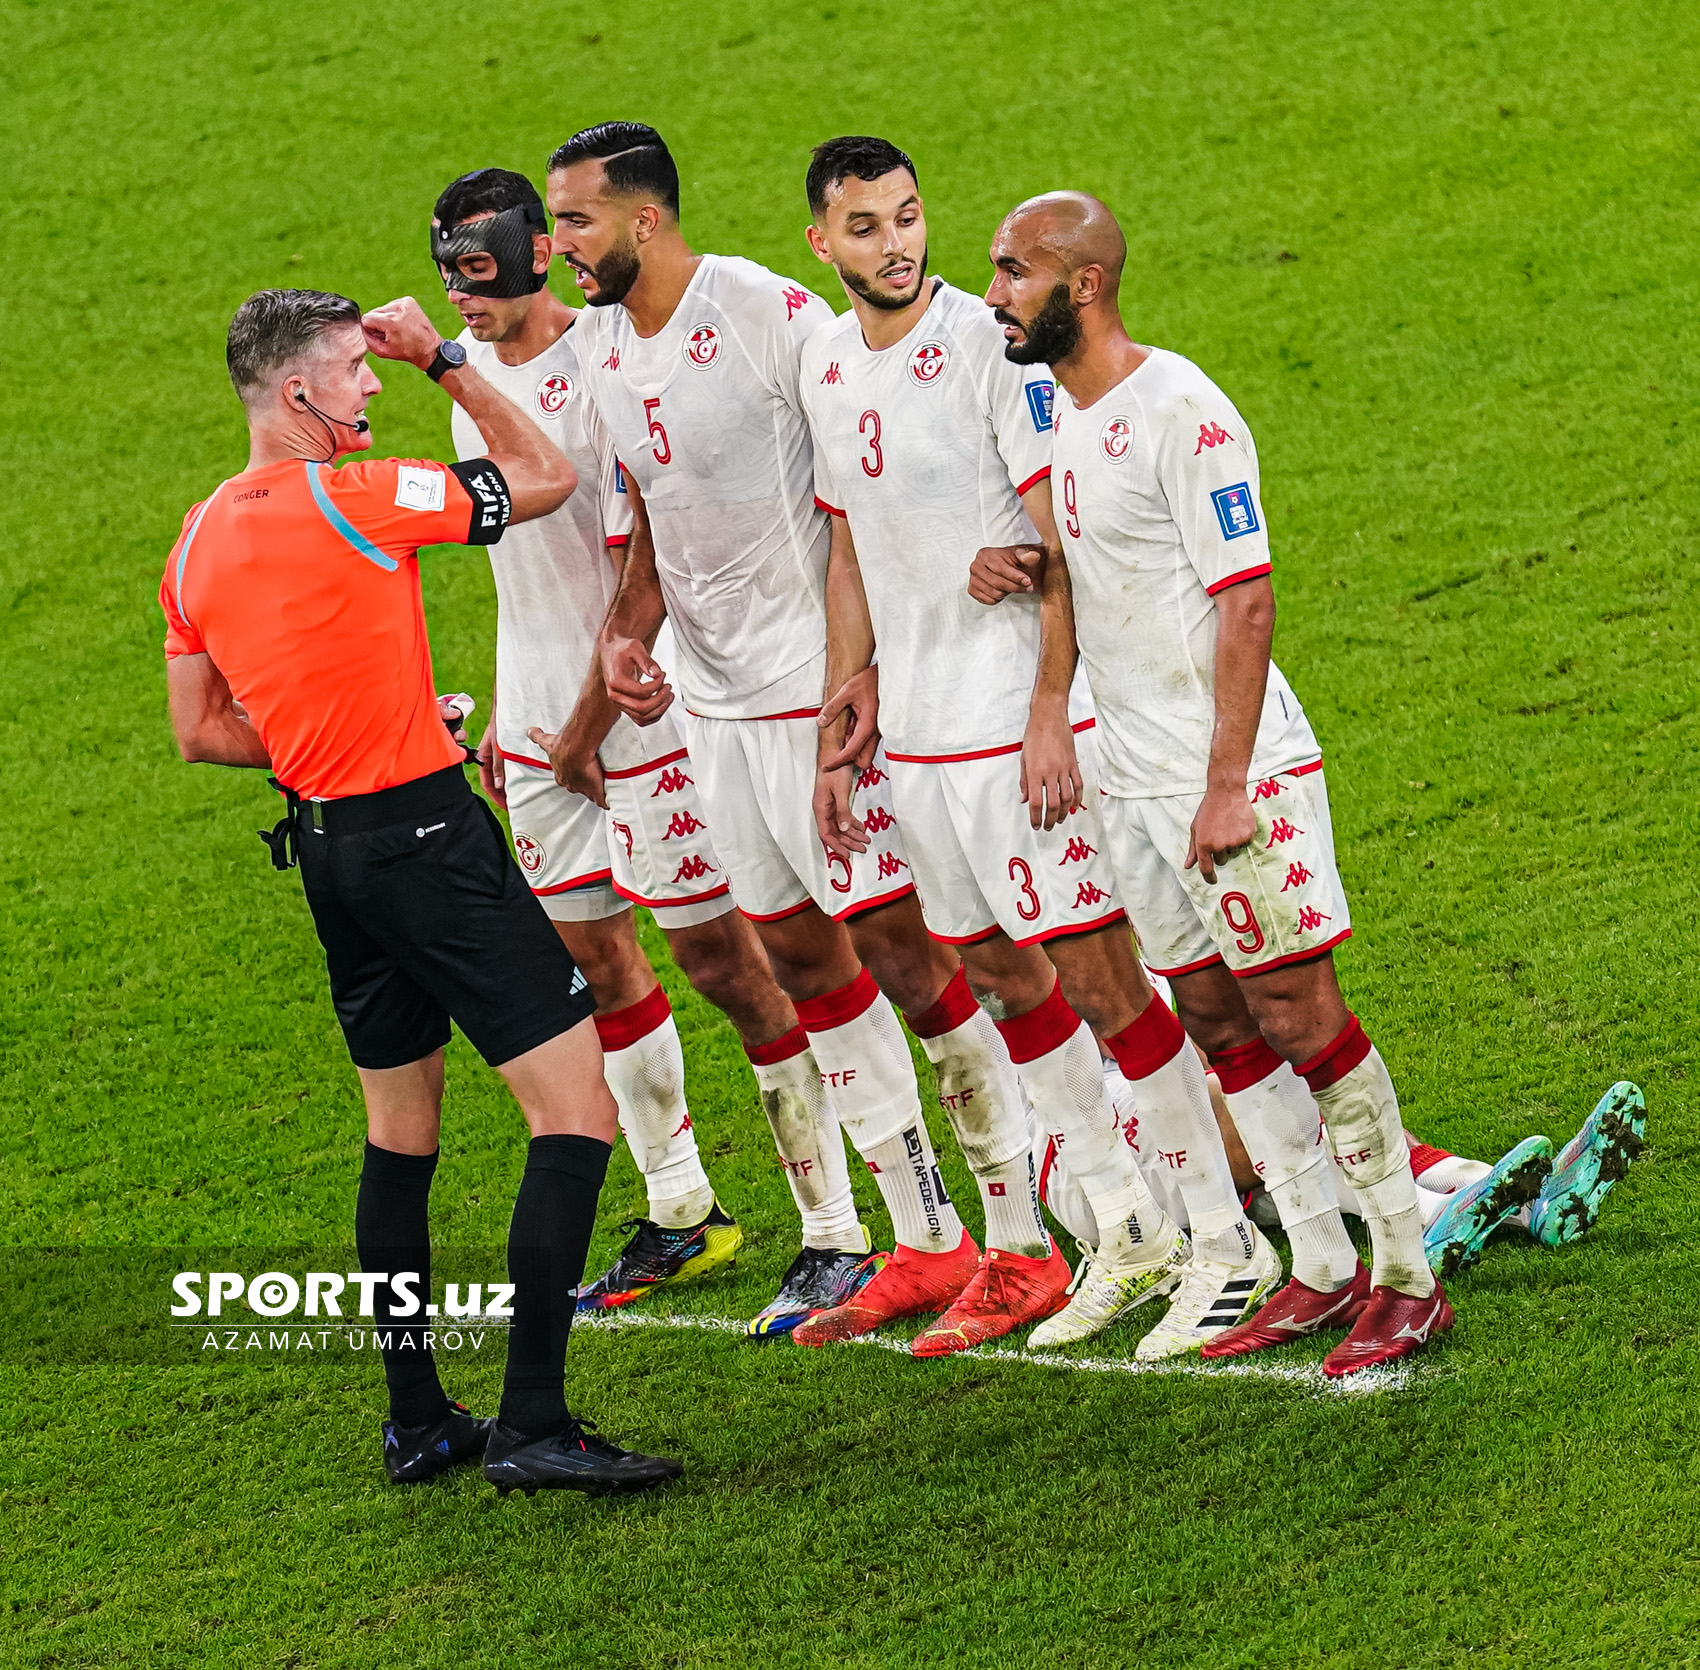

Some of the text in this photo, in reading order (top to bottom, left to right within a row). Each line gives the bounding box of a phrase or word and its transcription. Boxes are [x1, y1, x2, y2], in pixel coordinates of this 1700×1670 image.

[643, 397, 671, 465] 5
[859, 408, 883, 478] 3
[232, 489, 270, 503] CONGER
[470, 474, 499, 528] FIFA
[500, 494, 511, 526] TEAM
[1064, 469, 1081, 538] 9
[1008, 856, 1041, 921] 3
[1220, 891, 1265, 954] 9
[819, 1069, 857, 1087] FTF
[937, 1087, 974, 1109] FTF
[1157, 1149, 1187, 1168] FTF
[1333, 1147, 1372, 1167] FTF
[912, 1154, 943, 1238] TAPEDESIGN
[660, 1233, 681, 1241] COPA
[1127, 1213, 1144, 1243] SIGN
